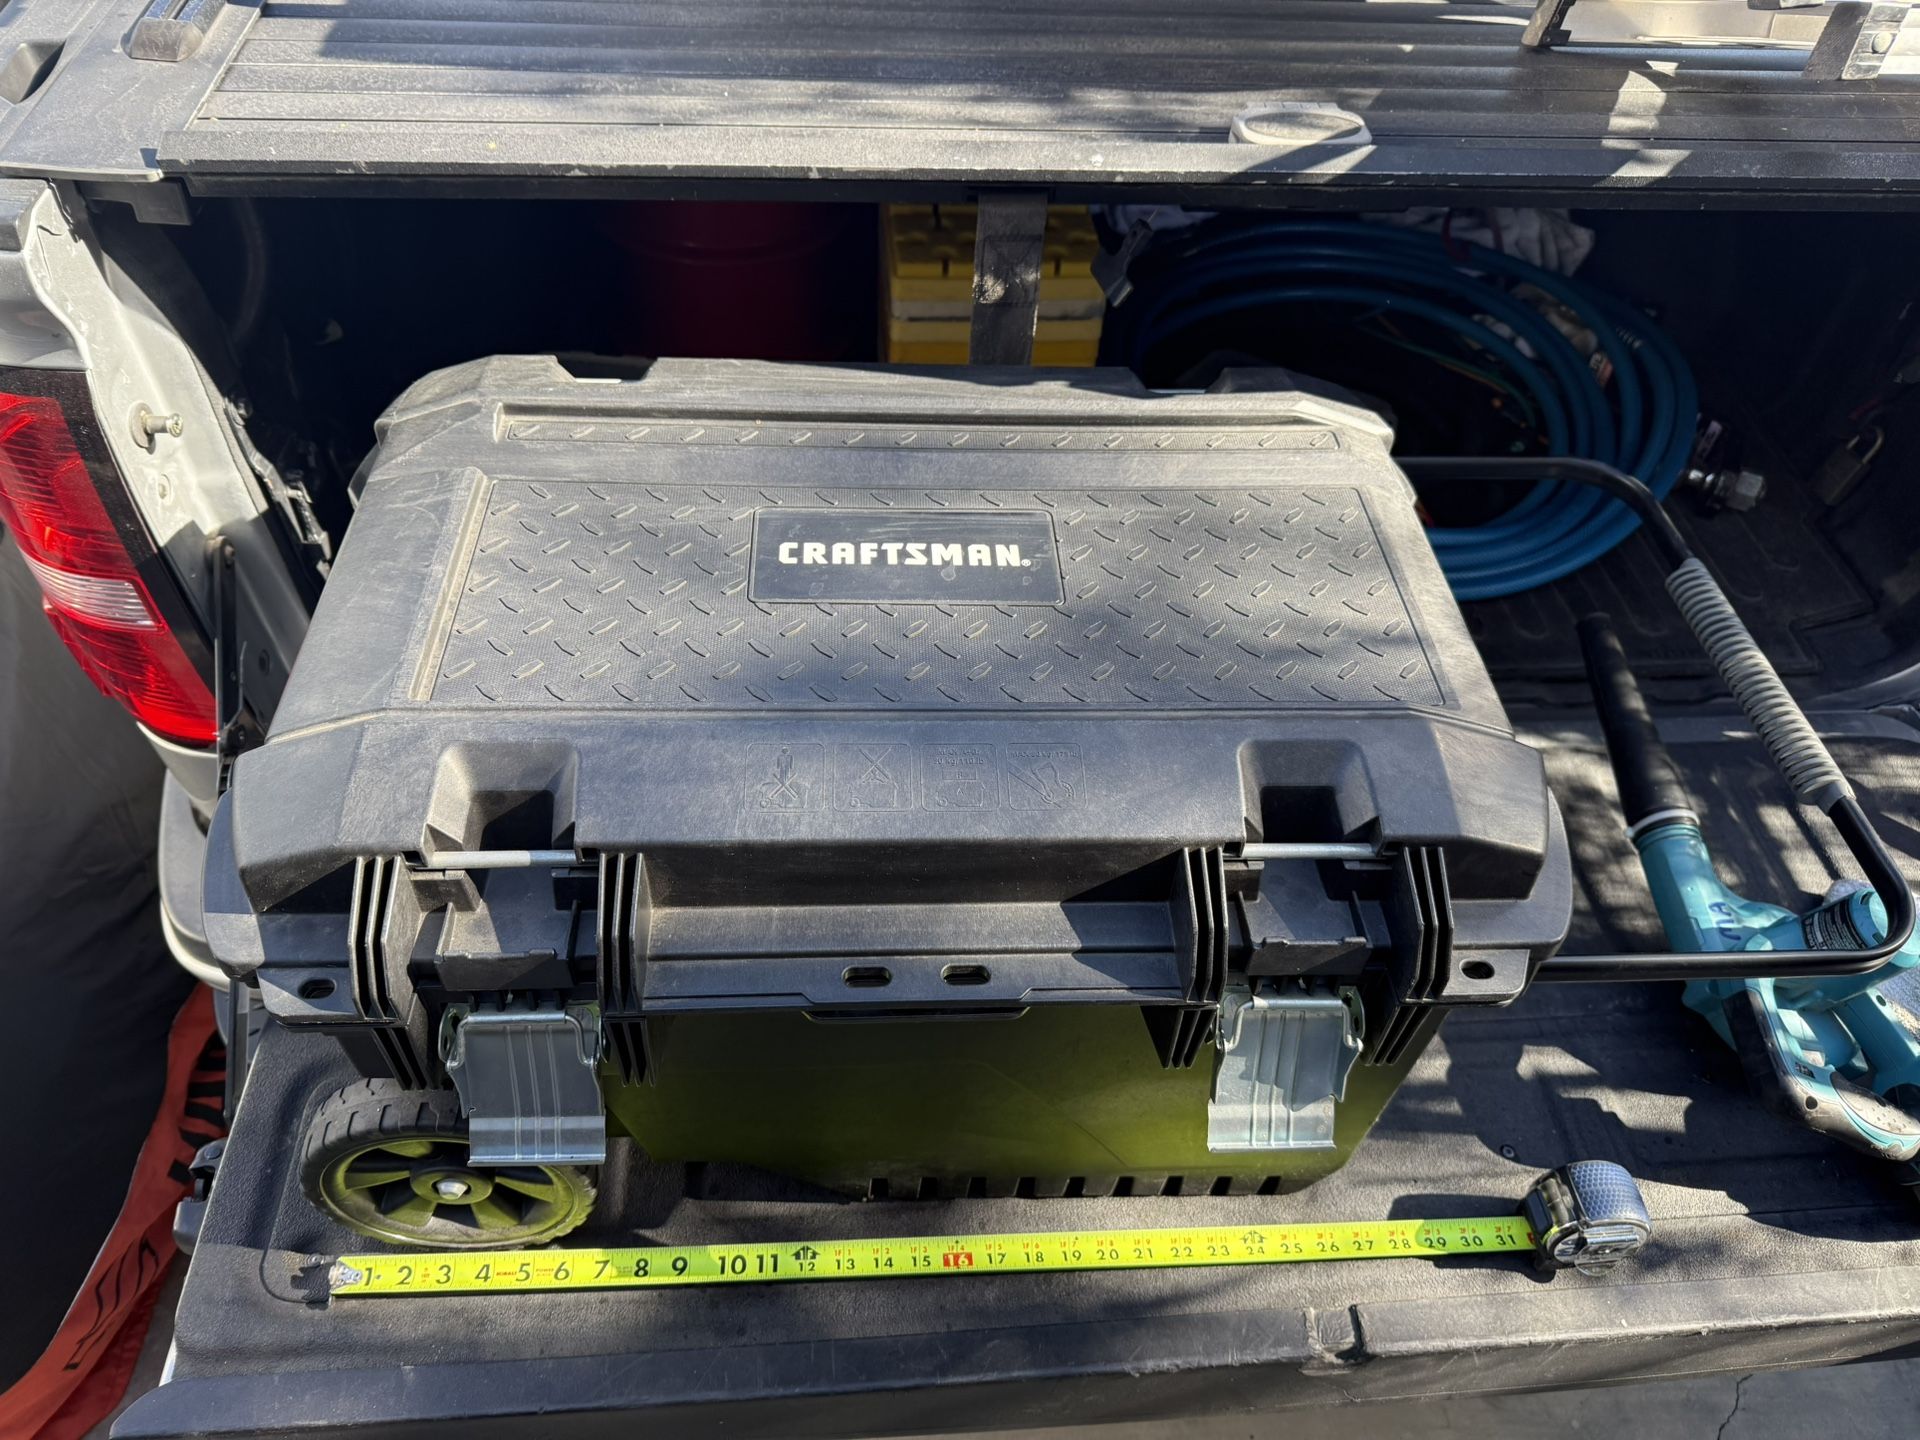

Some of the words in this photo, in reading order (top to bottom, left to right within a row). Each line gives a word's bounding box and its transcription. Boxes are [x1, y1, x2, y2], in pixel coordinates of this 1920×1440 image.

[779, 541, 1021, 567] CRAFTSMAN
[363, 1267, 373, 1286] 1
[396, 1265, 412, 1285] 2
[435, 1264, 451, 1285] 3
[475, 1263, 491, 1282] 4
[515, 1262, 531, 1281] 5
[553, 1260, 570, 1281] 6
[594, 1259, 611, 1279] 7
[633, 1257, 649, 1277] 8
[671, 1256, 688, 1276] 9
[718, 1254, 747, 1275] 10
[756, 1253, 779, 1274] 11
[798, 1261, 816, 1273] 12
[835, 1258, 855, 1270] 13
[873, 1257, 893, 1269] 14
[911, 1256, 931, 1267] 15
[947, 1254, 969, 1266] 16
[986, 1252, 1006, 1264] 17
[1024, 1252, 1044, 1263] 18
[1062, 1250, 1082, 1261] 19
[1096, 1249, 1119, 1260] 20
[1133, 1248, 1153, 1259] 21
[1170, 1246, 1193, 1258] 22
[1207, 1245, 1230, 1257] 23
[1246, 1246, 1265, 1255] 24
[1280, 1242, 1303, 1254] 25
[1316, 1240, 1340, 1252] 26
[1352, 1240, 1373, 1251] 27
[1389, 1239, 1411, 1249] 28
[1424, 1237, 1447, 1249] 29
[1460, 1235, 1483, 1247] 30
[1495, 1234, 1517, 1246] 31
